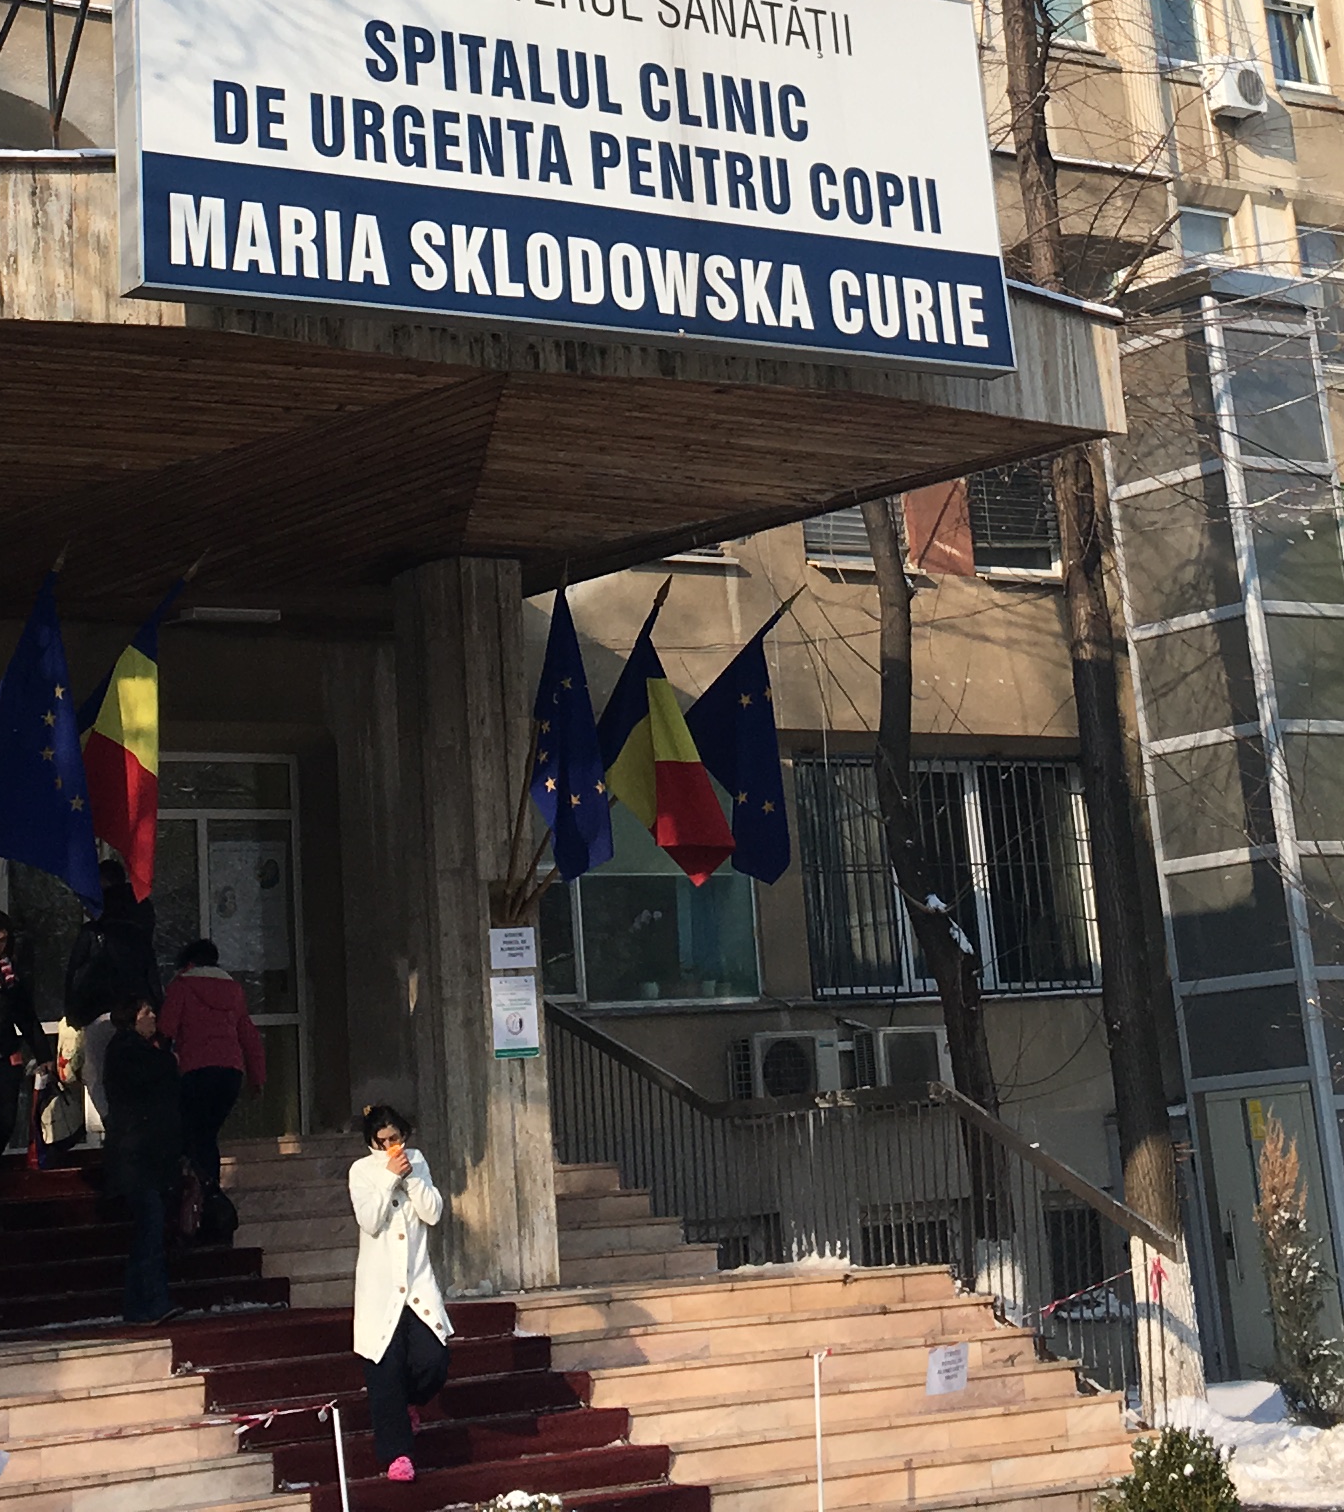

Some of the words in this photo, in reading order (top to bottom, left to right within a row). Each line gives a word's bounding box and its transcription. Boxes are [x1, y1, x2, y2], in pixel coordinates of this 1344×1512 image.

[213, 79, 288, 151] DE
[310, 92, 573, 186] URGENTA
[589, 130, 791, 215] PENTRU
[809, 162, 942, 234] COPII
[364, 19, 623, 115] SPITALUL
[639, 62, 809, 142] CLINIC
[169, 192, 391, 286] MARIA
[410, 220, 815, 330] SKLODOWSKA
[829, 269, 989, 348] CURIE
